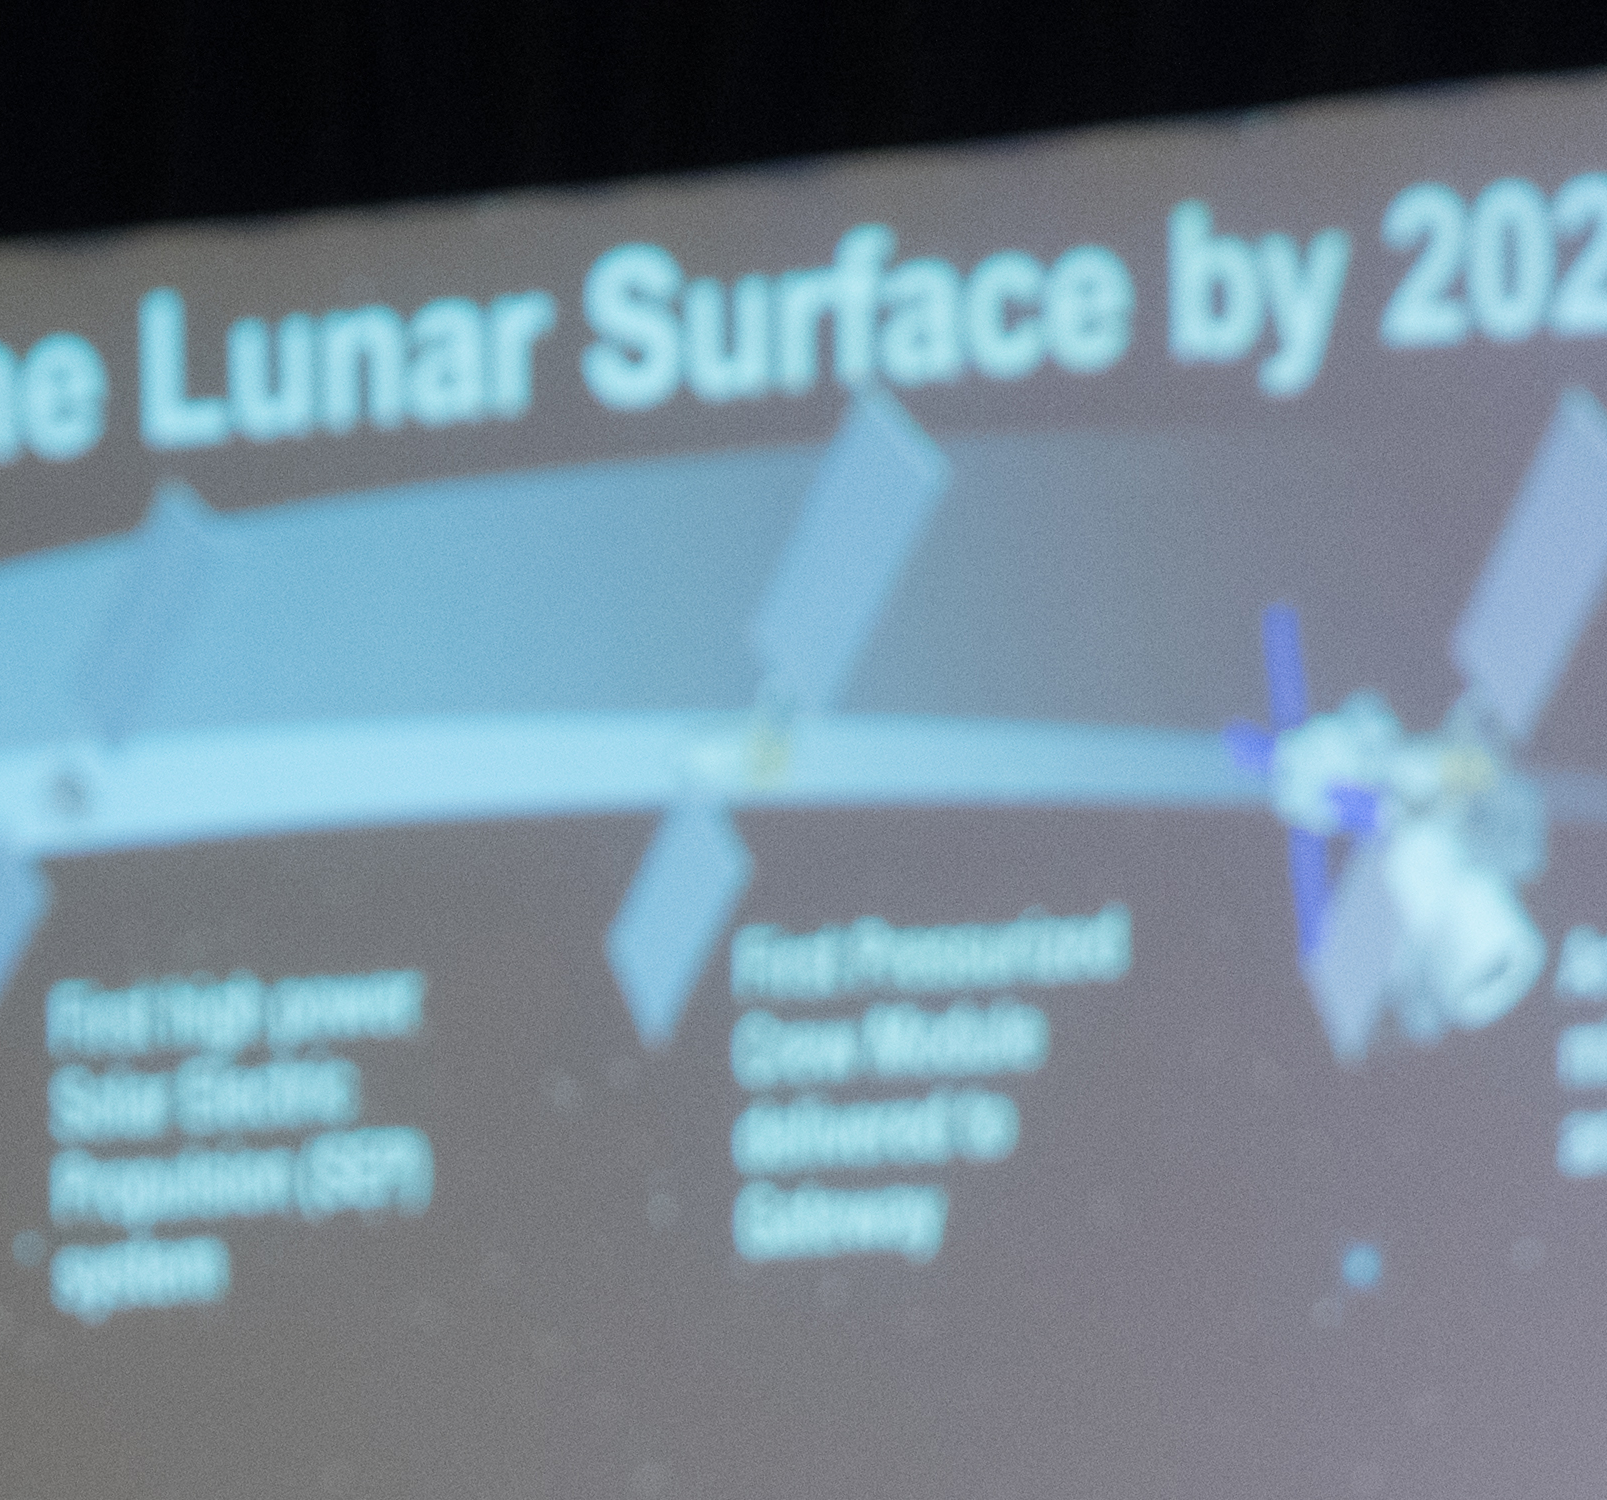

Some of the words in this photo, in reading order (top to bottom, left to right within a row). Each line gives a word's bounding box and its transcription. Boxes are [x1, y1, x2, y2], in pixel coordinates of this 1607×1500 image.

[139, 286, 556, 453] Lunar
[580, 220, 1136, 409] Surface
[1167, 198, 1351, 398] by
